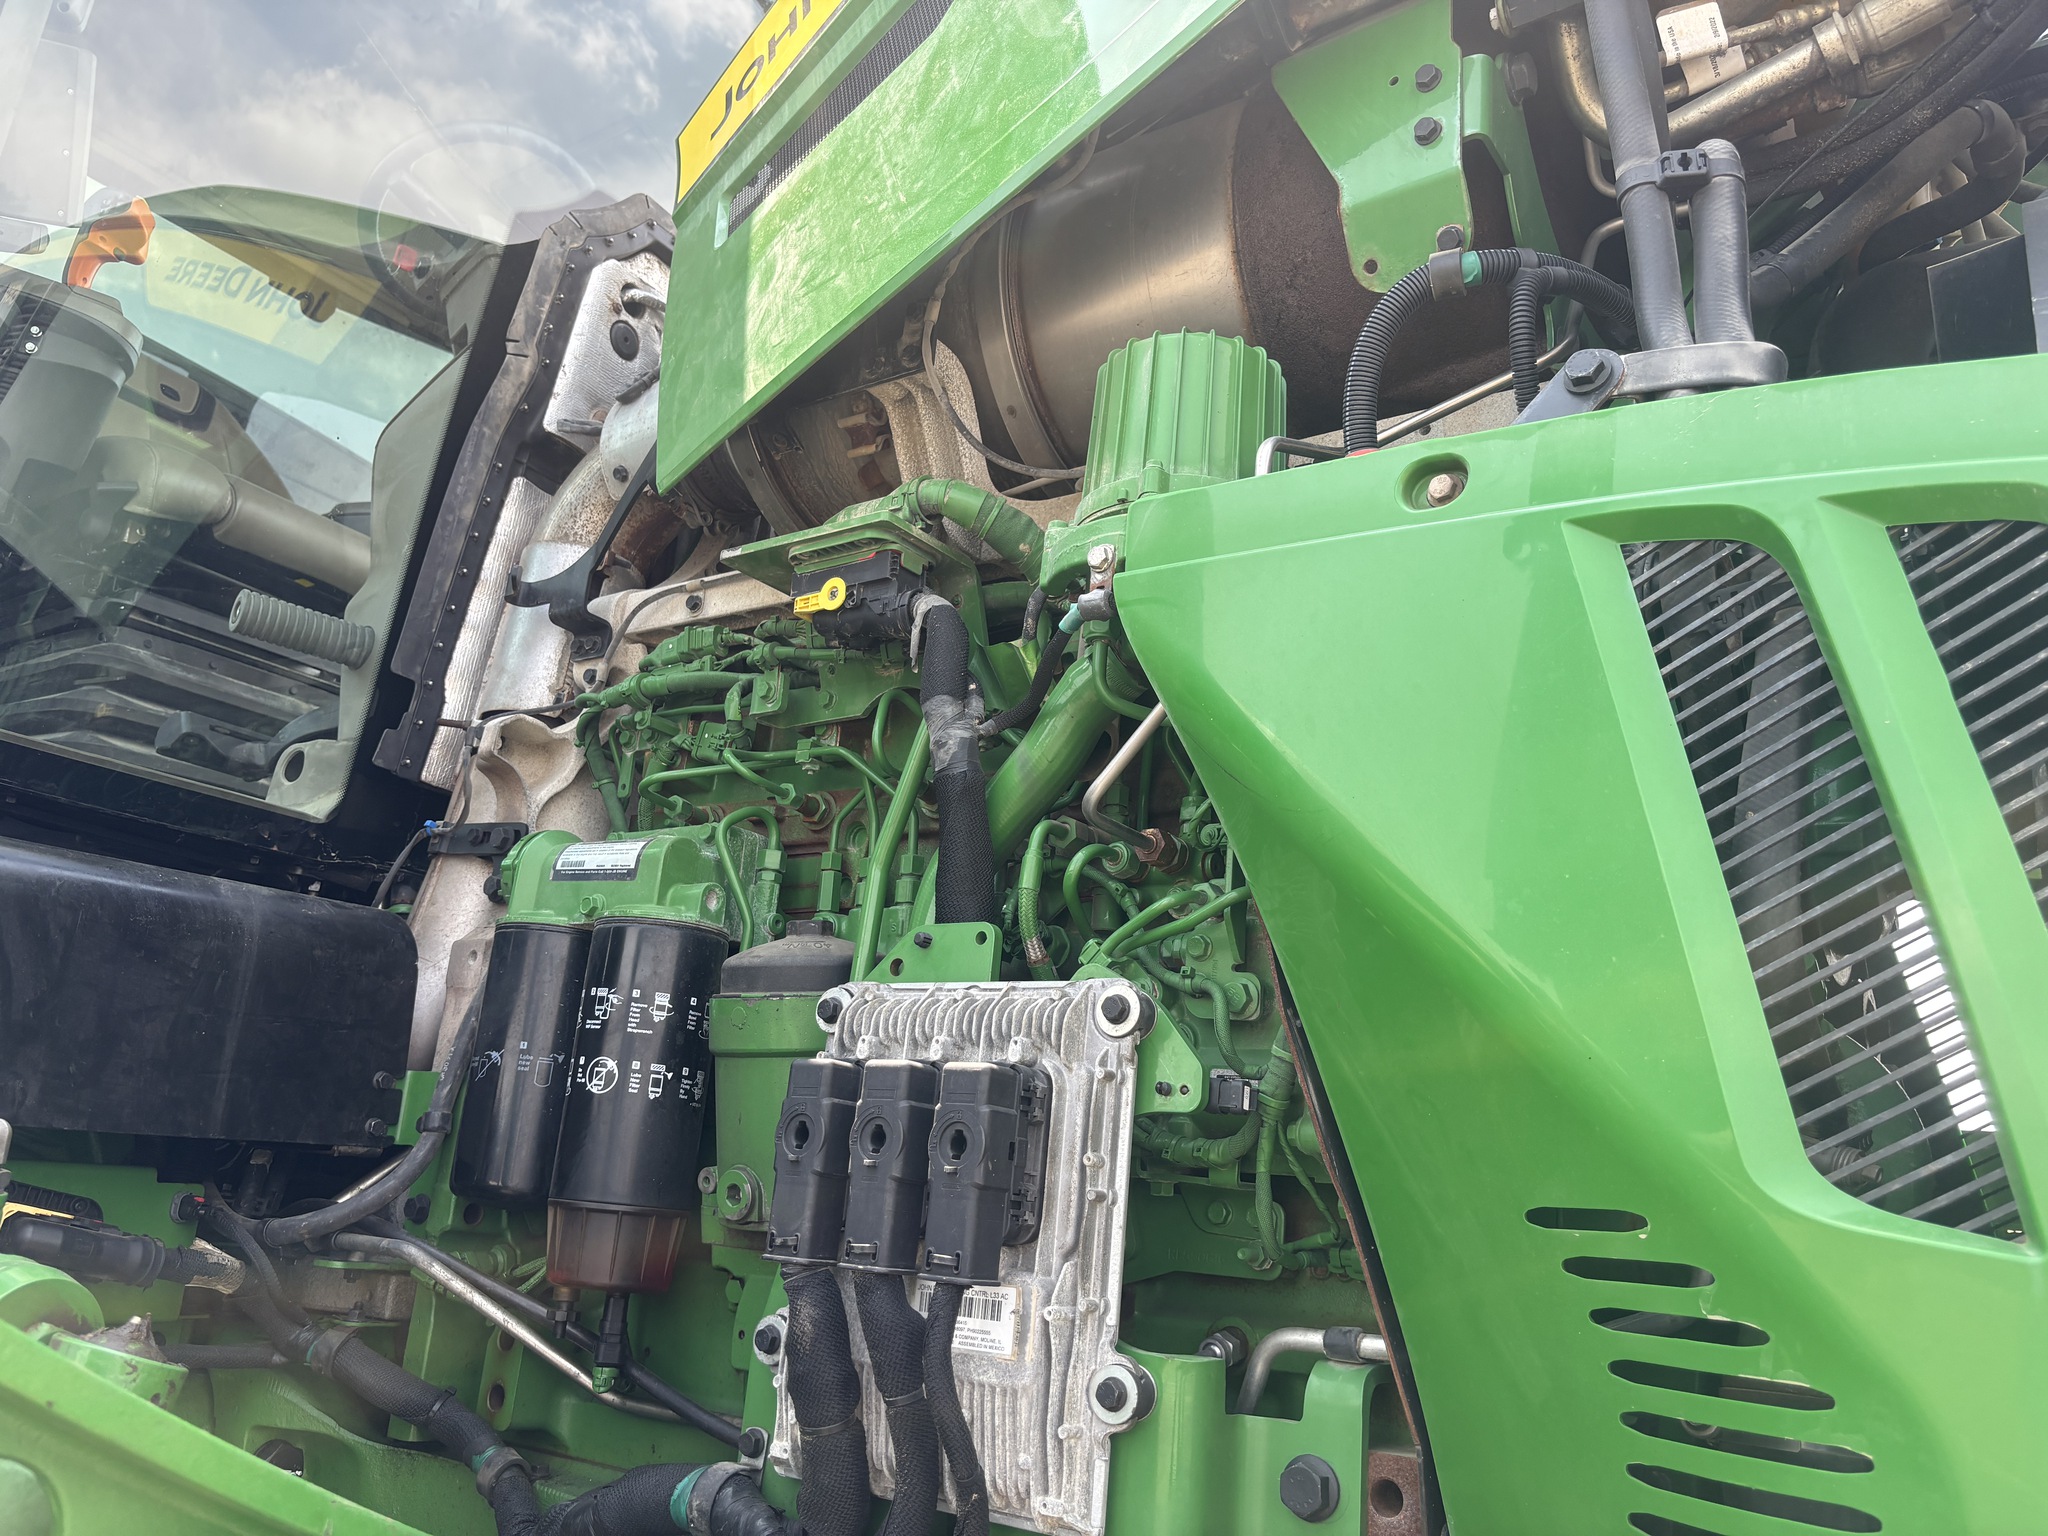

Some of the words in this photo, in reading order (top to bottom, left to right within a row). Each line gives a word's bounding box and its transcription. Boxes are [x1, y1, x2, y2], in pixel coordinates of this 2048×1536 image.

[1667, 26, 1675, 38] USA
[710, 0, 811, 140] JOH
[918, 1283, 933, 1291] JOHN
[970, 1289, 990, 1298] CNTRL
